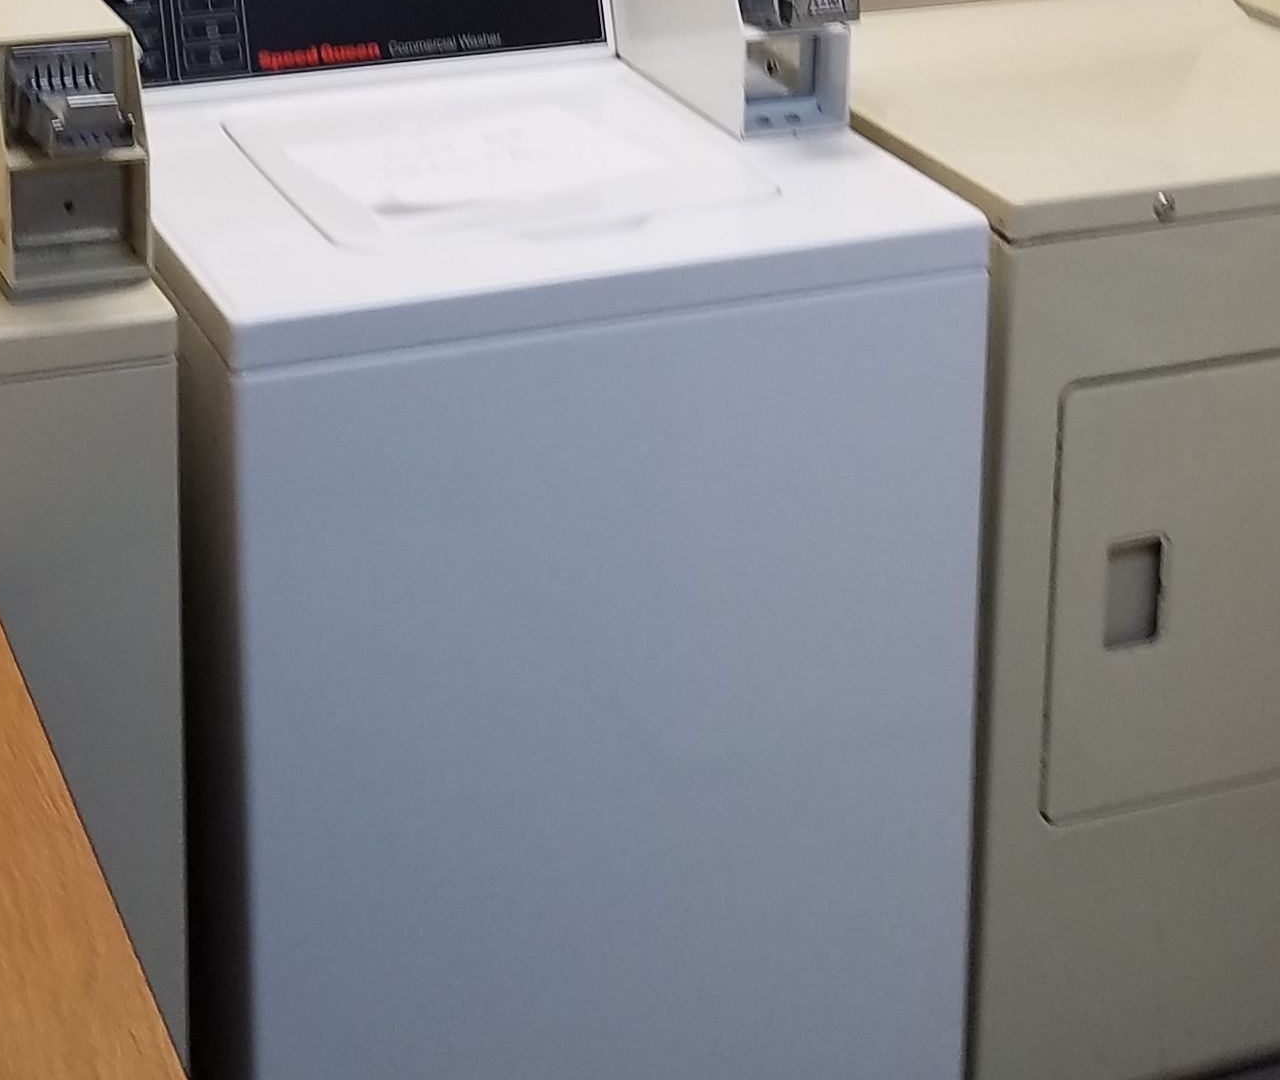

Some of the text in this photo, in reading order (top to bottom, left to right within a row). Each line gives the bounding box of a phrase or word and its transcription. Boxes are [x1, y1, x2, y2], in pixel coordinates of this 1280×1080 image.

[257, 45, 320, 71] Speed
[320, 39, 383, 64] Queen
[458, 31, 502, 51] Washer
